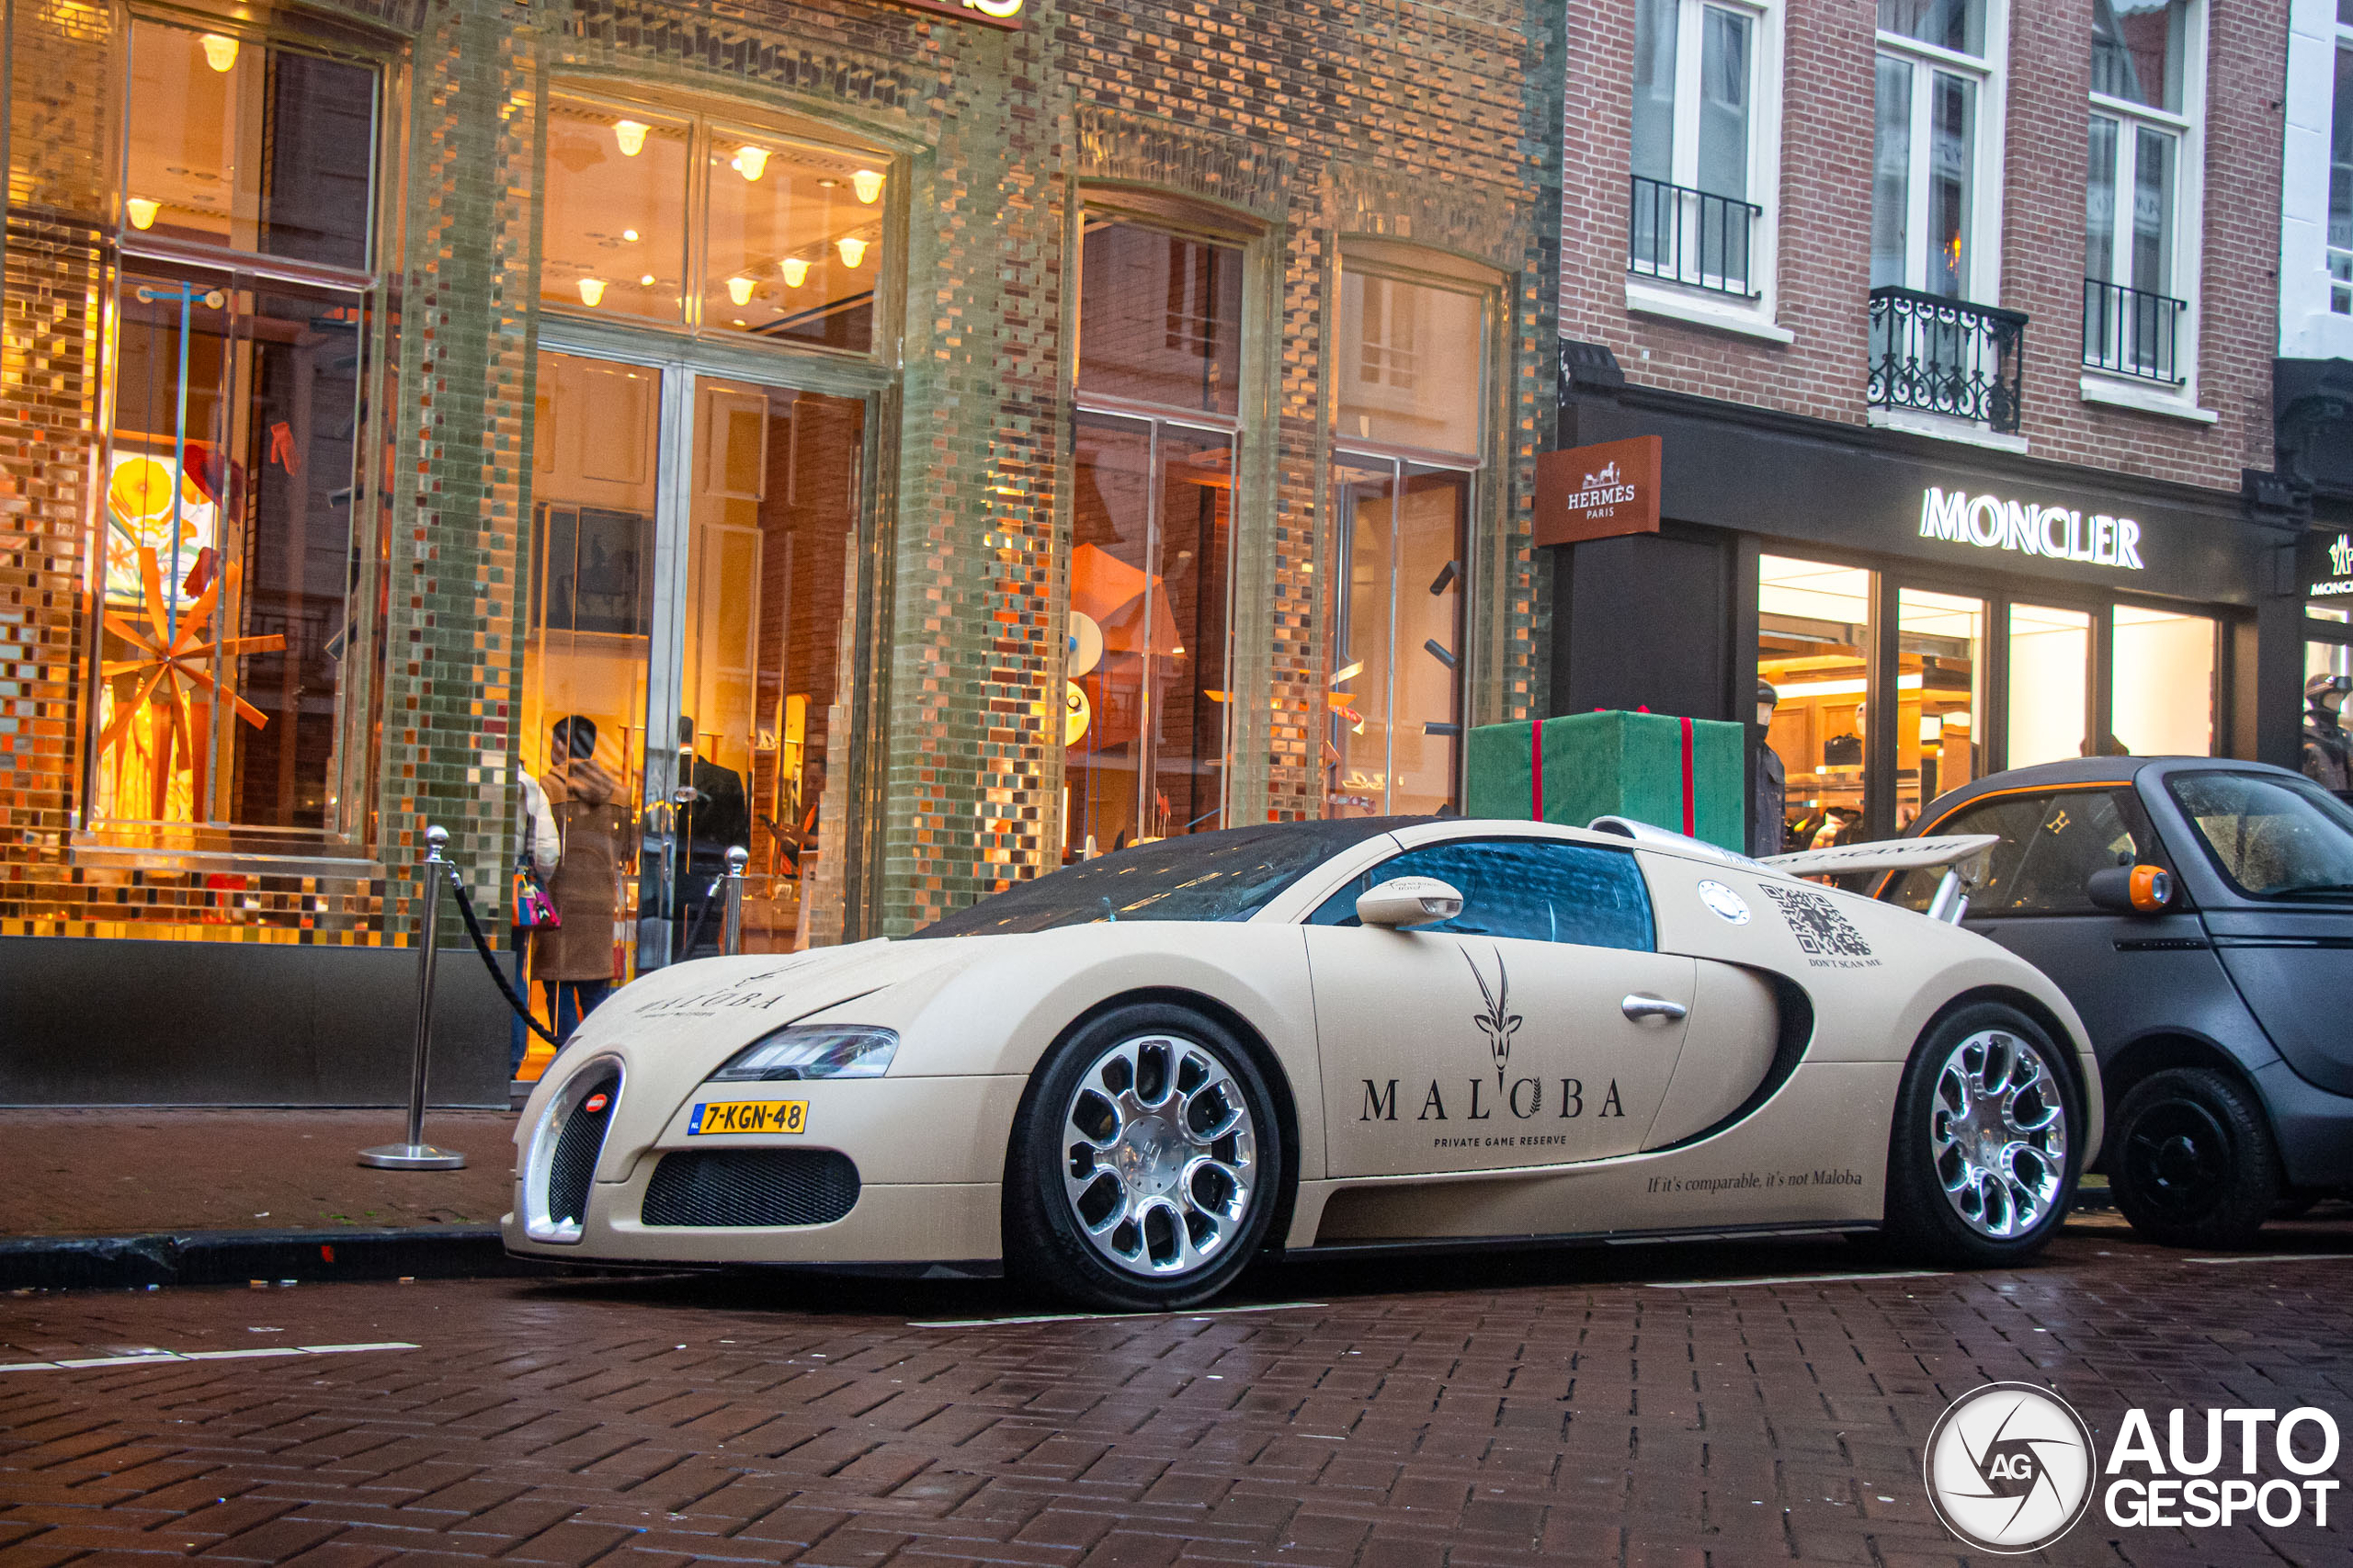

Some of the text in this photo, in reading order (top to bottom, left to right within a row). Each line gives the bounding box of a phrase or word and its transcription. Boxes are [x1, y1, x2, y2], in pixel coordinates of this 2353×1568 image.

[1568, 484, 1635, 510] HERMÈS
[1586, 506, 1615, 520] PARIS
[1919, 487, 2144, 570] MONCLER
[1808, 959, 1882, 969] DON'T SCAN ME
[1358, 1076, 1626, 1121] MALOBA
[706, 1105, 801, 1130] 7-KGN-48
[1434, 1135, 1567, 1148] PRIVATE GAME RESERVE
[1647, 1169, 1863, 1194] If it's comparable, it's not Maloba
